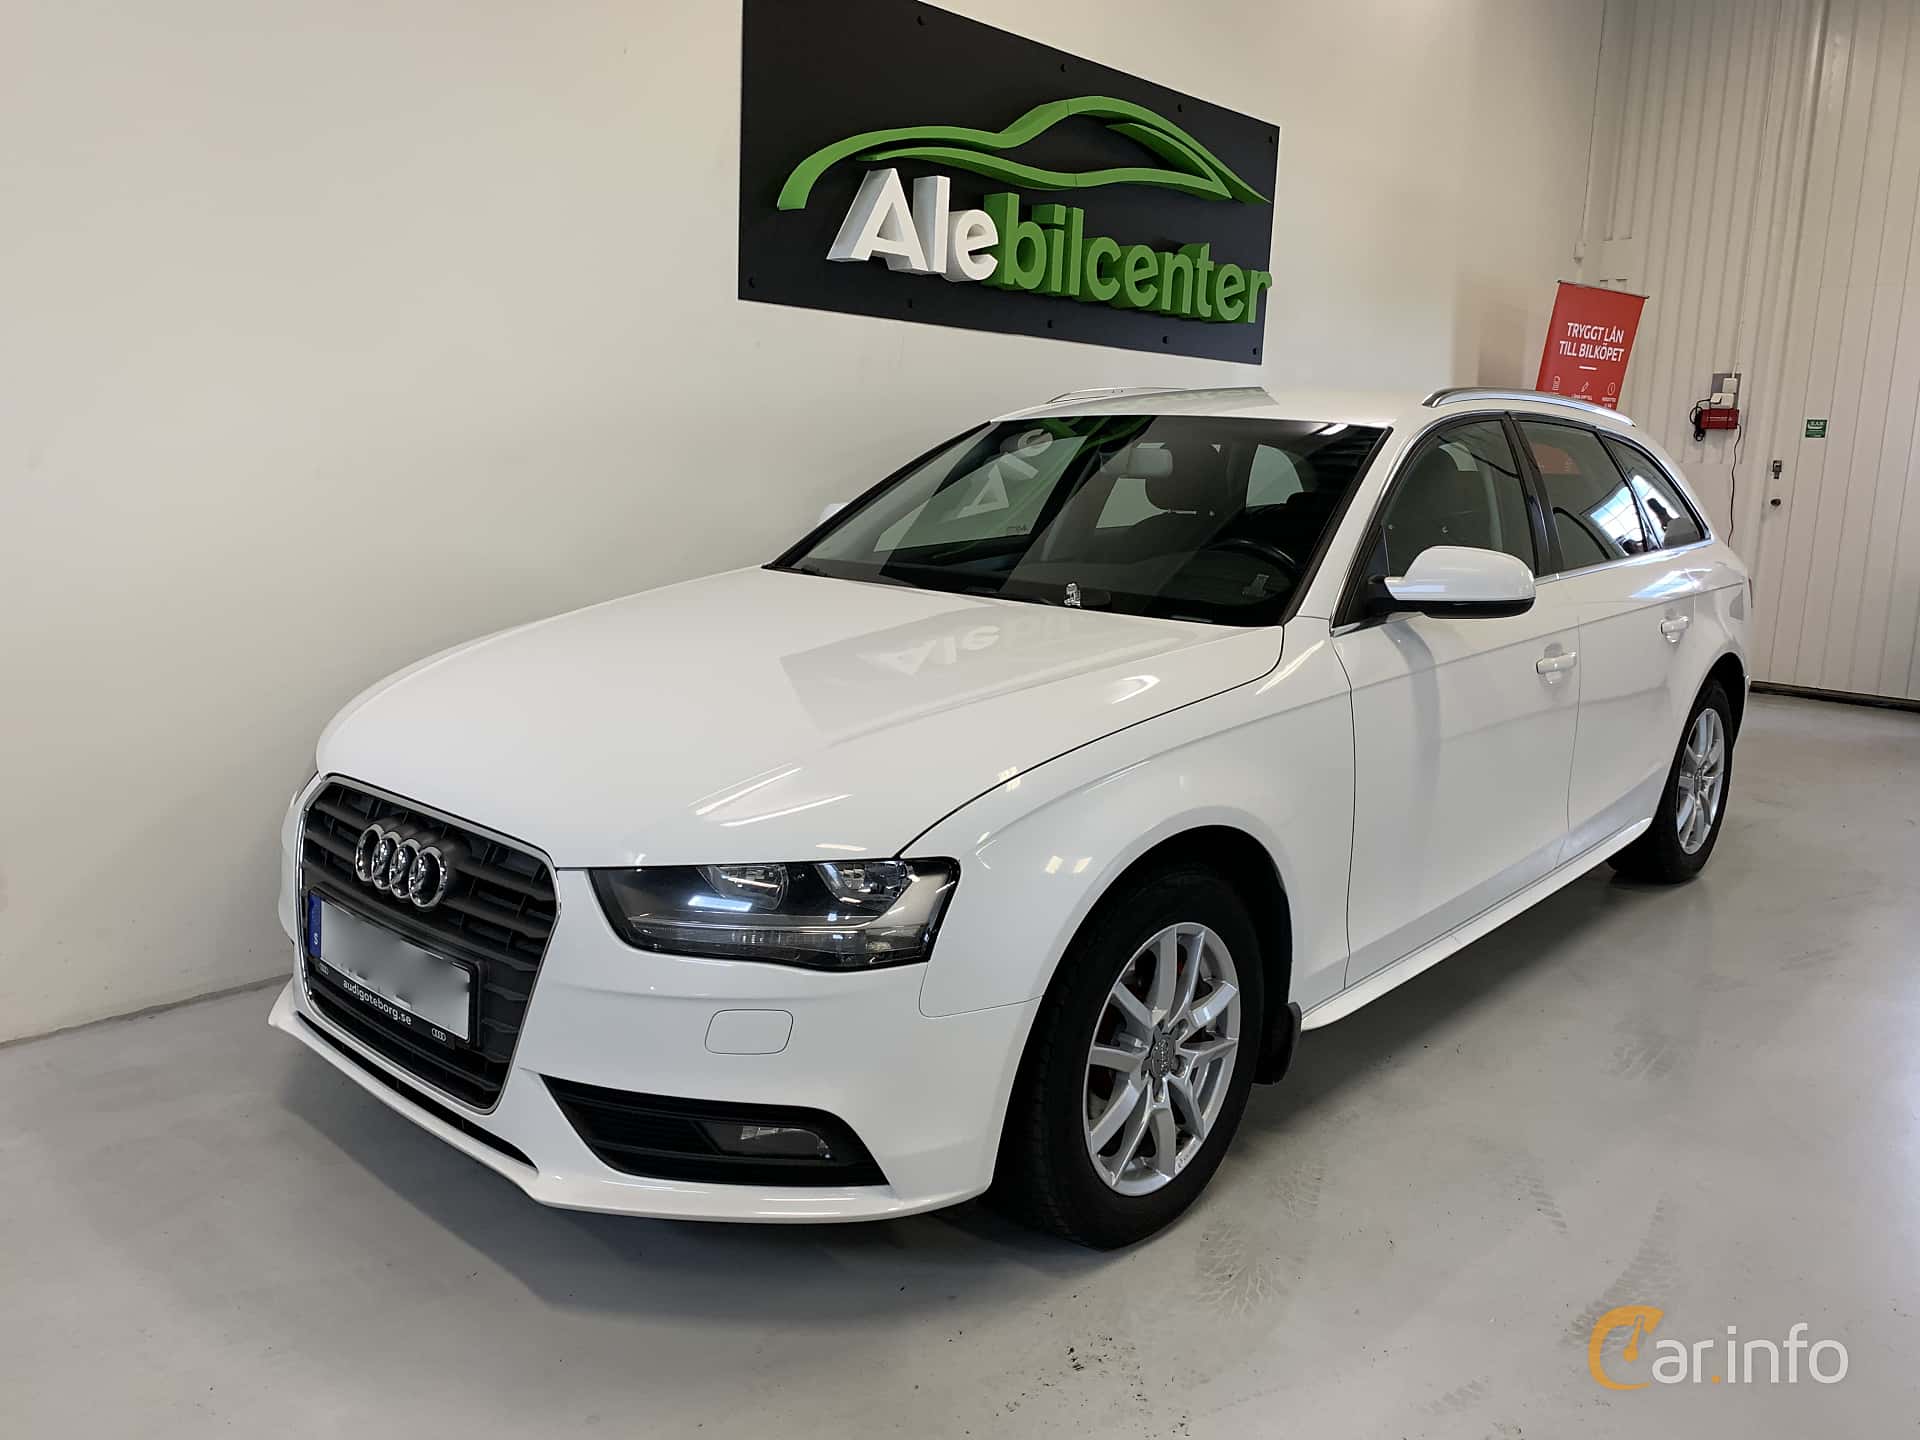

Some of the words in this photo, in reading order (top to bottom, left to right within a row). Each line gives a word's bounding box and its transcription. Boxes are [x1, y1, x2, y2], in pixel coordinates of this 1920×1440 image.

[1567, 322, 1605, 341] TRYGGT
[1604, 326, 1625, 344] LÅN
[1559, 340, 1577, 357] TILL
[1578, 342, 1625, 362] BILKÖPET
[343, 979, 412, 1025] audigoteborg.se
